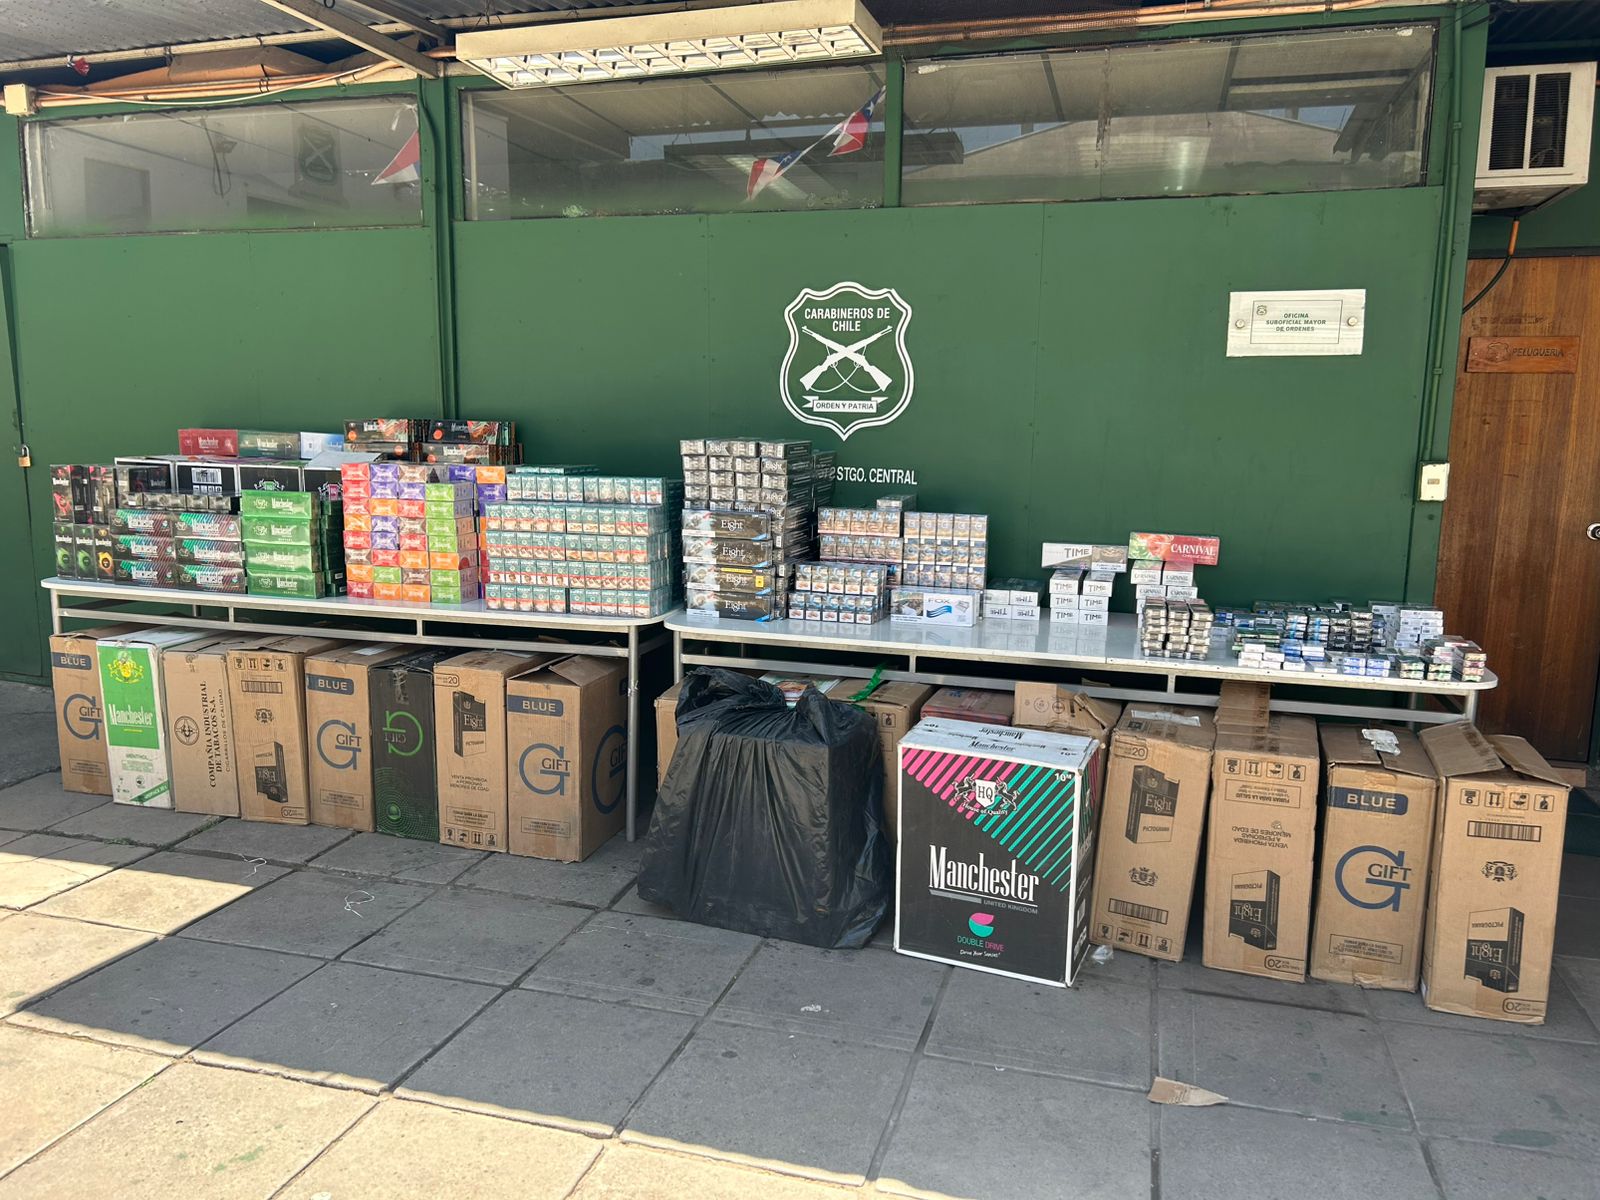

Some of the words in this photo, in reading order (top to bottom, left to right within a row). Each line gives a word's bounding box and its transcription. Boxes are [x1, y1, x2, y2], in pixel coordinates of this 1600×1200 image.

[804, 307, 874, 319] CARABINEROS
[877, 307, 890, 319] DE
[832, 320, 861, 332] CHILE
[1512, 347, 1564, 357] PELUQUERIA
[815, 402, 840, 410] ORDEN
[841, 402, 847, 410] Y
[847, 402, 874, 410] PATRIA
[836, 466, 867, 483] STGO.
[869, 468, 917, 485] CENTRAL
[721, 519, 743, 531] Eight
[722, 546, 744, 559] Eight
[1064, 547, 1090, 558] TIME
[1170, 544, 1216, 556] CARNIVAL
[726, 573, 747, 586] Eight
[1088, 584, 1107, 592] TIME
[725, 600, 746, 612] Eight
[1055, 597, 1073, 605] TIME
[1085, 599, 1103, 607] TIME
[990, 607, 1007, 615] TIME
[1017, 609, 1036, 617] TIME
[1055, 611, 1074, 620] TIME
[1084, 613, 1103, 621] TIME
[60, 656, 87, 667] BLUE
[318, 678, 348, 691] BLUE
[447, 676, 458, 685] 20
[200, 680, 212, 736] INDUSTRIAL
[209, 696, 217, 714] S.A.
[522, 700, 556, 713] BLUE
[79, 706, 102, 718] GIFT
[108, 703, 153, 726] Manchester
[464, 713, 484, 730] Eight
[209, 715, 221, 758] TABACOS
[383, 732, 407, 744] GIFT
[978, 727, 1025, 741] Manchester
[336, 733, 362, 748] GIFT
[968, 740, 1016, 753] Manchester
[1131, 746, 1146, 758] 20
[214, 759, 222, 773] DE
[541, 757, 571, 772] GIFT
[977, 785, 994, 803] HQ
[1145, 793, 1172, 813] Eight
[1346, 793, 1397, 809] BLUE
[962, 801, 980, 813] House
[987, 808, 1009, 816] Quality
[1231, 825, 1249, 833] EDAD
[1260, 829, 1292, 838] MENORES
[1233, 837, 1267, 846] PROHIBIDA
[1241, 832, 1275, 842] PERSONAS
[1268, 841, 1289, 849] VENTA
[928, 844, 1040, 902] Manchester
[1367, 863, 1412, 881] GIFT
[983, 900, 1007, 909] UNITED
[1007, 904, 1038, 915] KINGDOM
[1235, 902, 1263, 922] Eight
[956, 935, 984, 948] DOUBLE
[984, 941, 1005, 952] DRIVE
[1471, 943, 1504, 963] Eight
[1267, 958, 1282, 968] 20
[1505, 1002, 1522, 1012] 20
